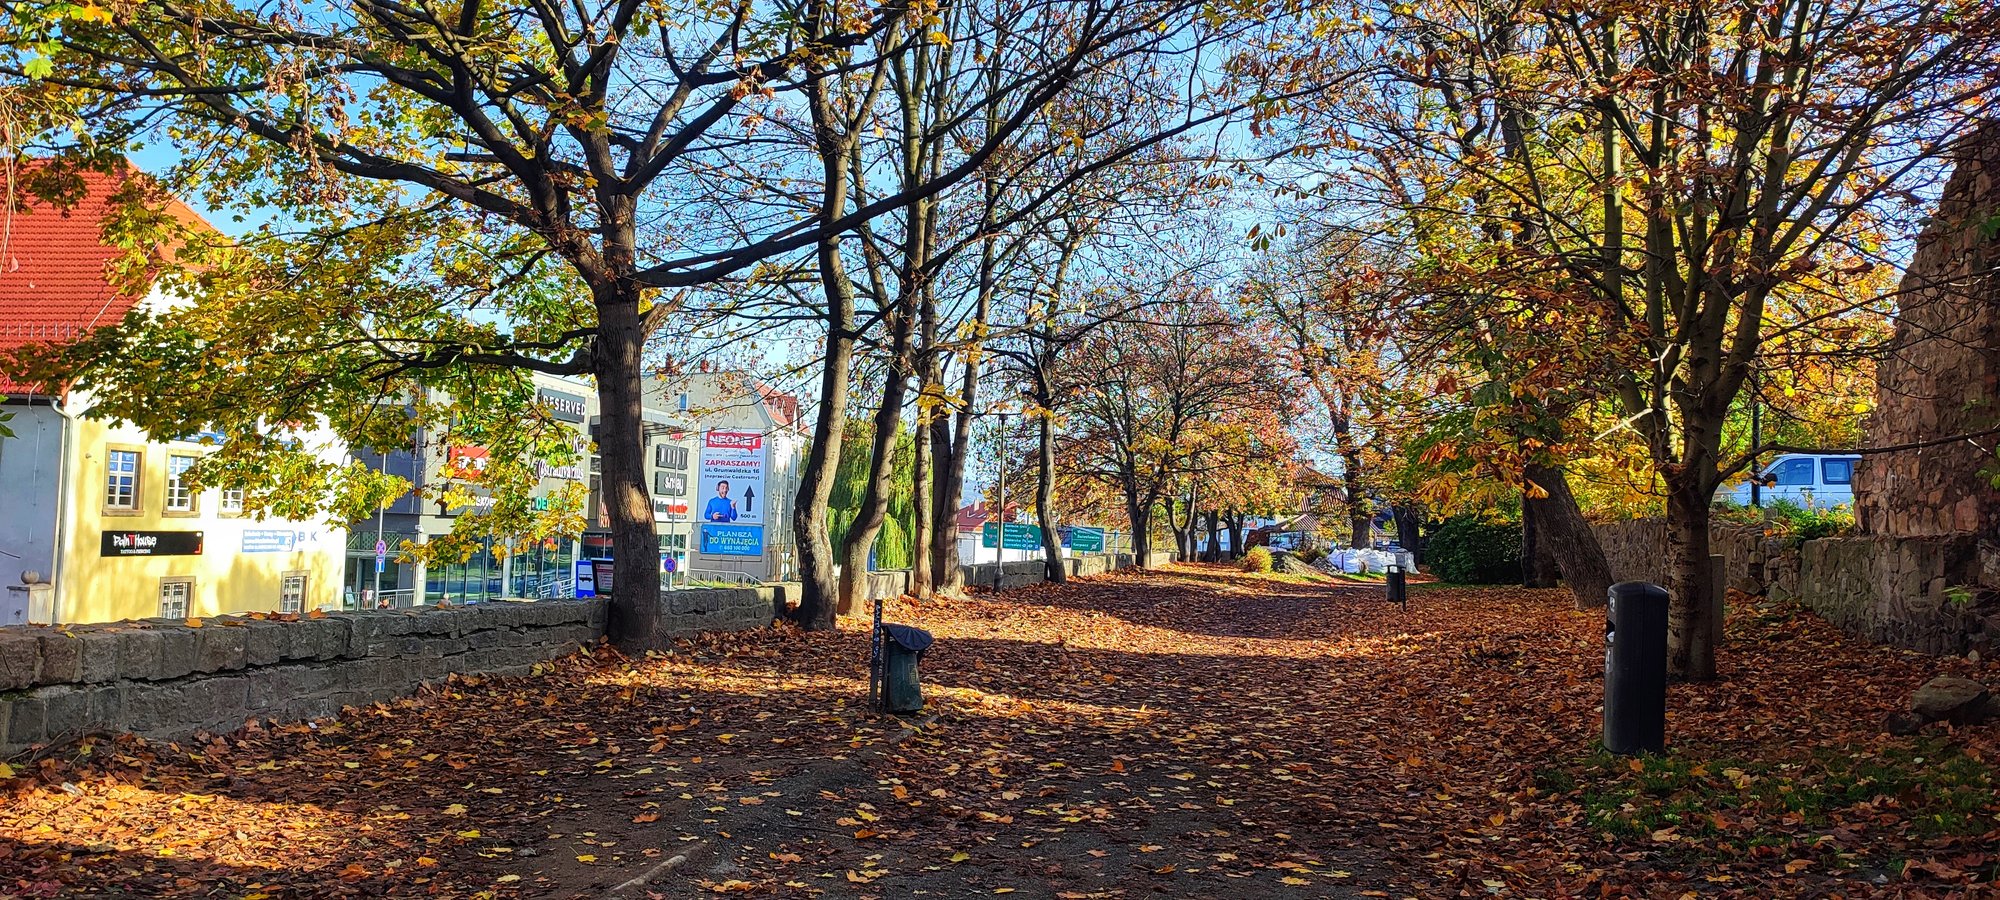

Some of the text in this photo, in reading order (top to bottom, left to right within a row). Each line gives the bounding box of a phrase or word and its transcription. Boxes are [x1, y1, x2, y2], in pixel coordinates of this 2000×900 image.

[543, 395, 586, 416] RESERVED
[710, 435, 756, 446] NEONET
[705, 460, 761, 468] ZAPRASZAMY!
[721, 537, 760, 546] WYNAJĘCIA
